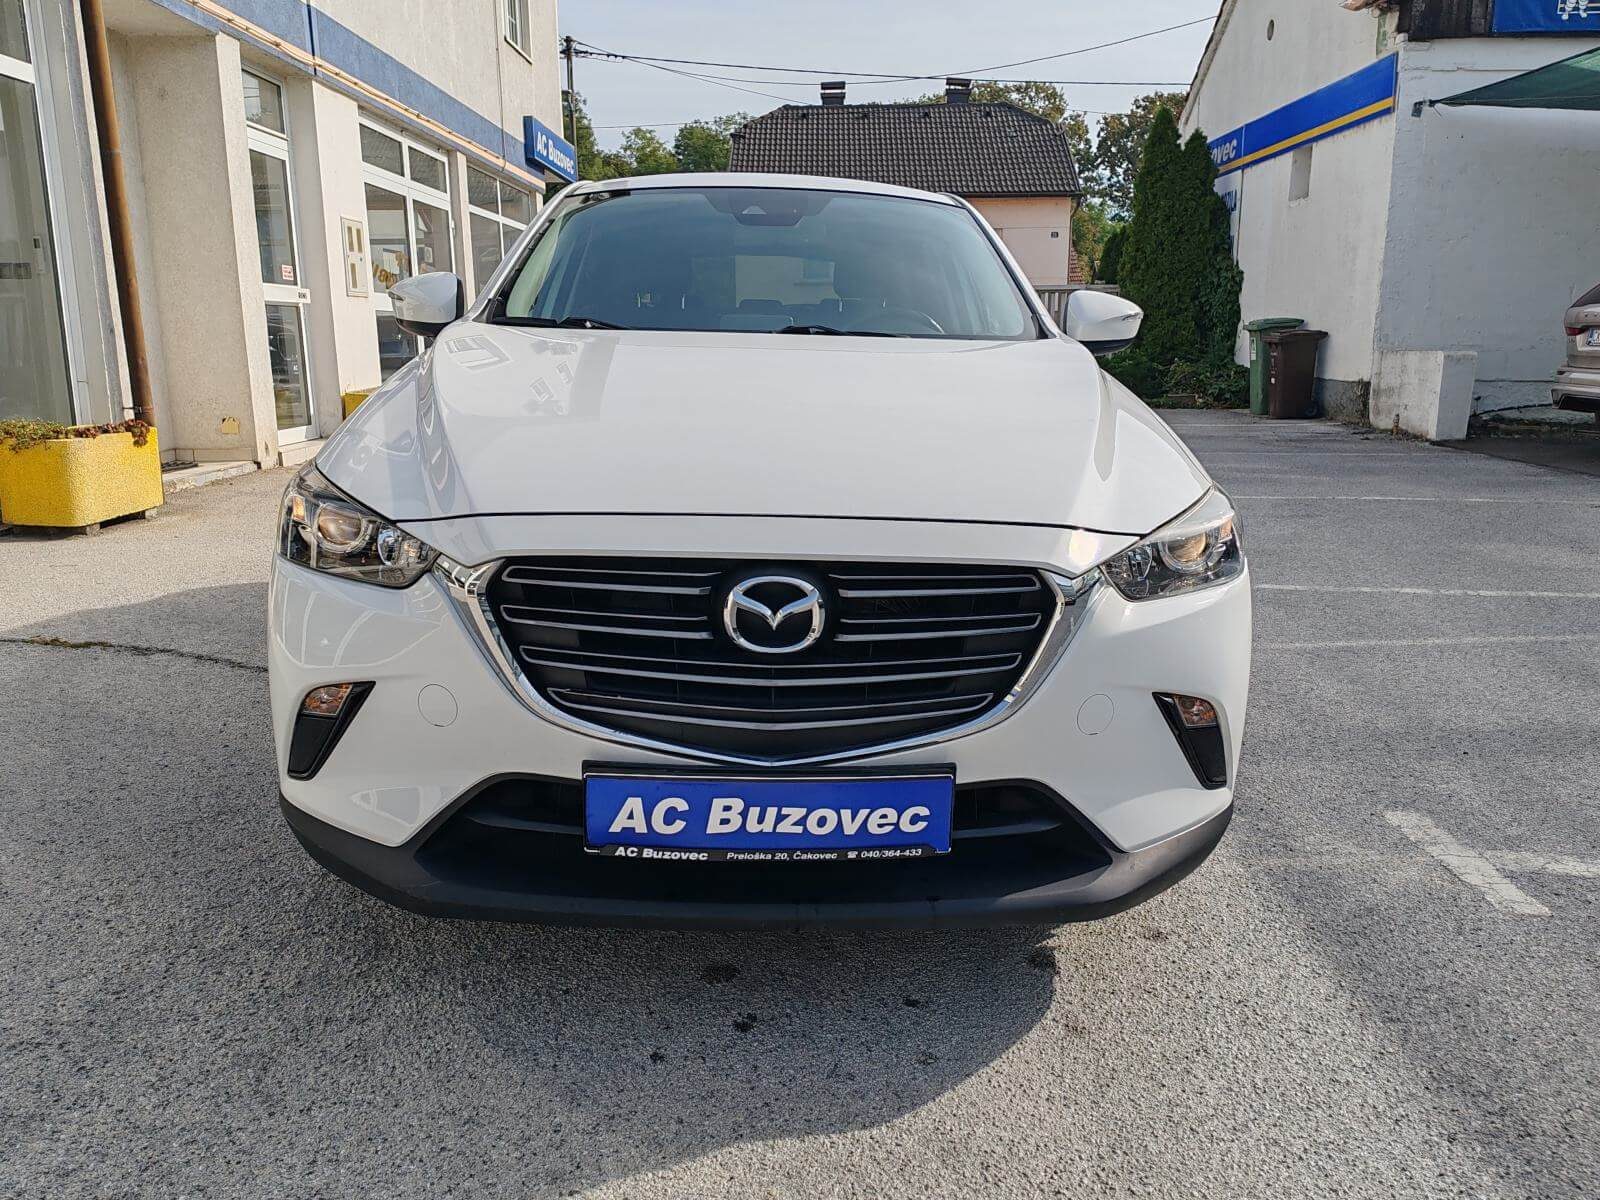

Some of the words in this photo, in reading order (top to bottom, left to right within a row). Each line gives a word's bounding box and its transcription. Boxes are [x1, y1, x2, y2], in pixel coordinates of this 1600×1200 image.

[536, 131, 547, 157] AC
[548, 138, 574, 175] Buzovec
[608, 797, 690, 835] AC
[706, 797, 931, 835] Buzovec
[614, 846, 639, 857] AC
[642, 848, 709, 860] Buzovec
[726, 852, 772, 860] Preloška
[793, 851, 838, 860] Čakovec
[860, 848, 922, 858] 040/364-433
